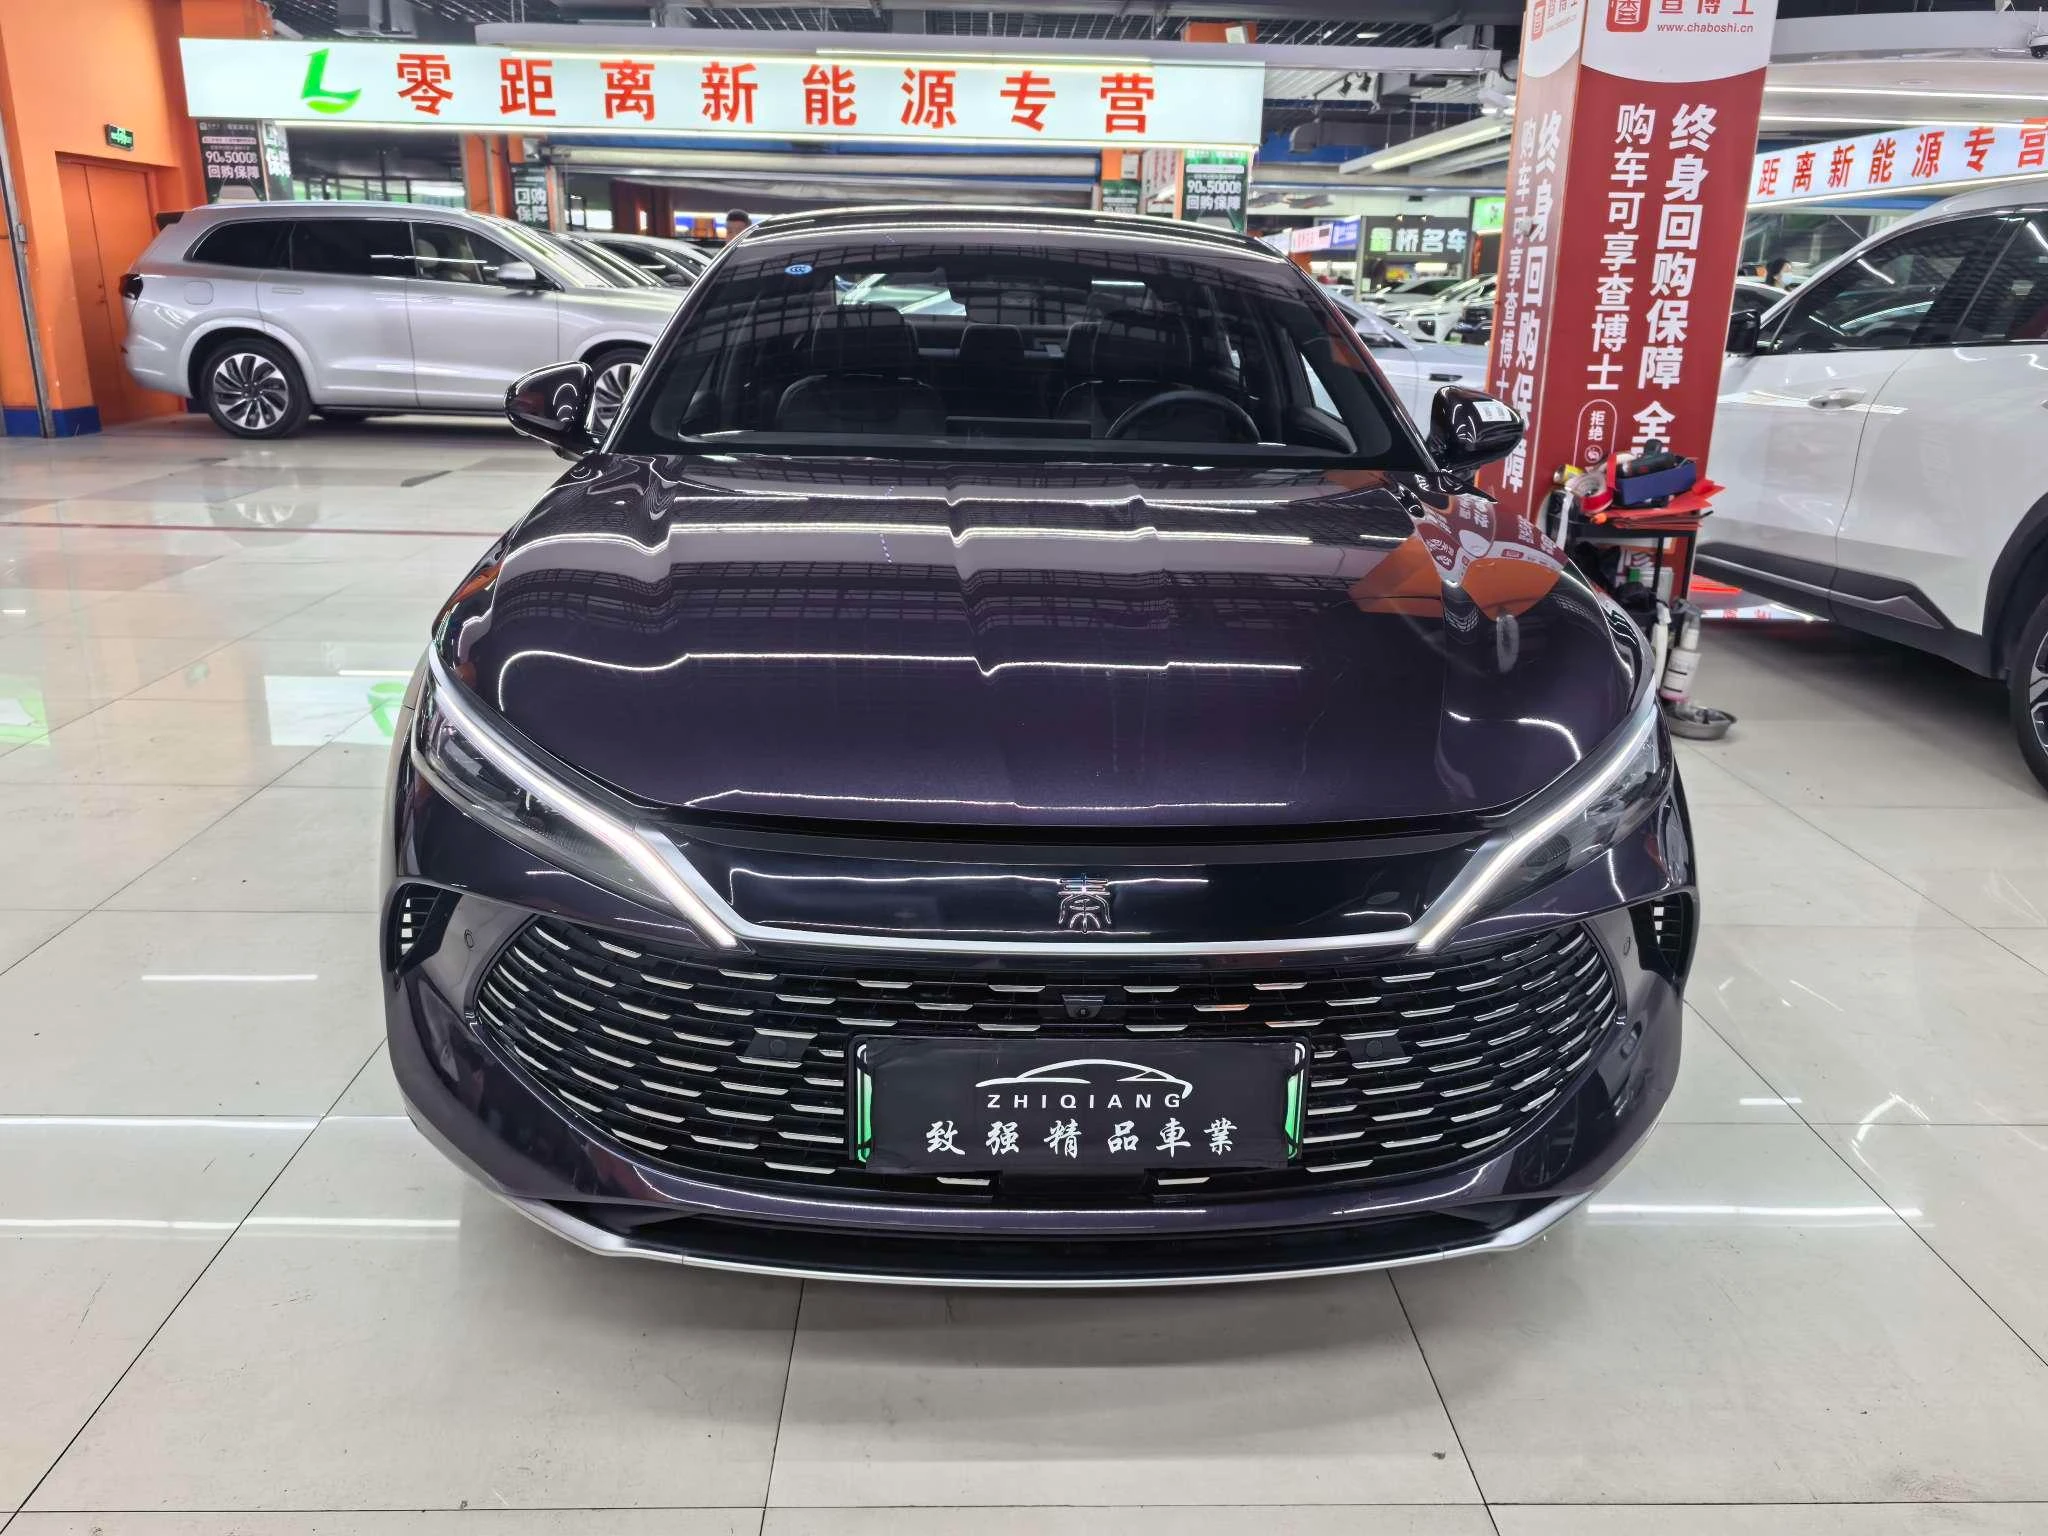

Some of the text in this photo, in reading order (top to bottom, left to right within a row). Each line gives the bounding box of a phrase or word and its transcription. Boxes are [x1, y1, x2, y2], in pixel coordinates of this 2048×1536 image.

[1656, 22, 1754, 33] www.chaboshi.cn
[396, 53, 1156, 134] 零距离新能源专营
[208, 165, 260, 179] 回购保障
[1186, 195, 1241, 210] 回购保障
[1587, 103, 1656, 391] 购车可享查博士
[1637, 103, 1718, 390] 终身回购保障
[1588, 410, 1606, 441] 拒绝
[987, 1093, 1181, 1109] ZHIQIANG
